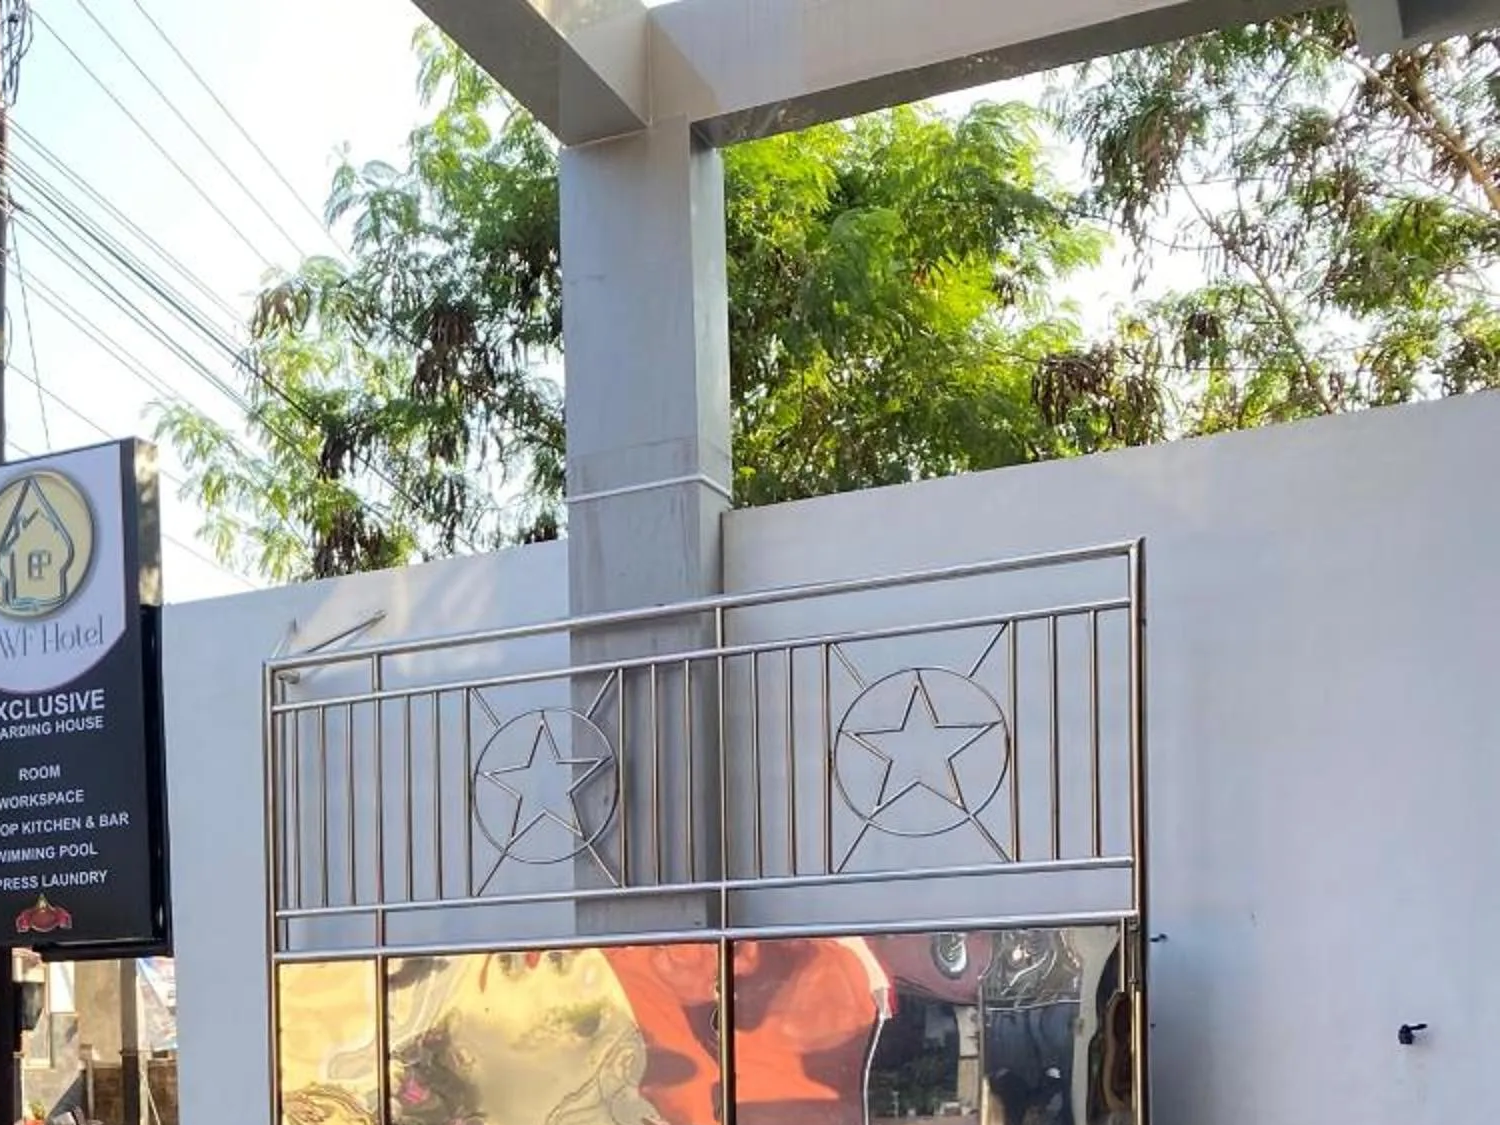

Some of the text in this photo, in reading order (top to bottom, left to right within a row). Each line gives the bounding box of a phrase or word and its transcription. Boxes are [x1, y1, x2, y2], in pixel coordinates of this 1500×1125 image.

[43, 614, 104, 655] Hotel
[55, 716, 104, 733] HOUSE
[19, 765, 61, 781] ROOM
[21, 816, 81, 835] KITCHEN
[85, 815, 96, 828] &
[99, 811, 130, 828] BAR
[59, 842, 99, 858] POOL
[41, 869, 109, 888] LAUNDRY
